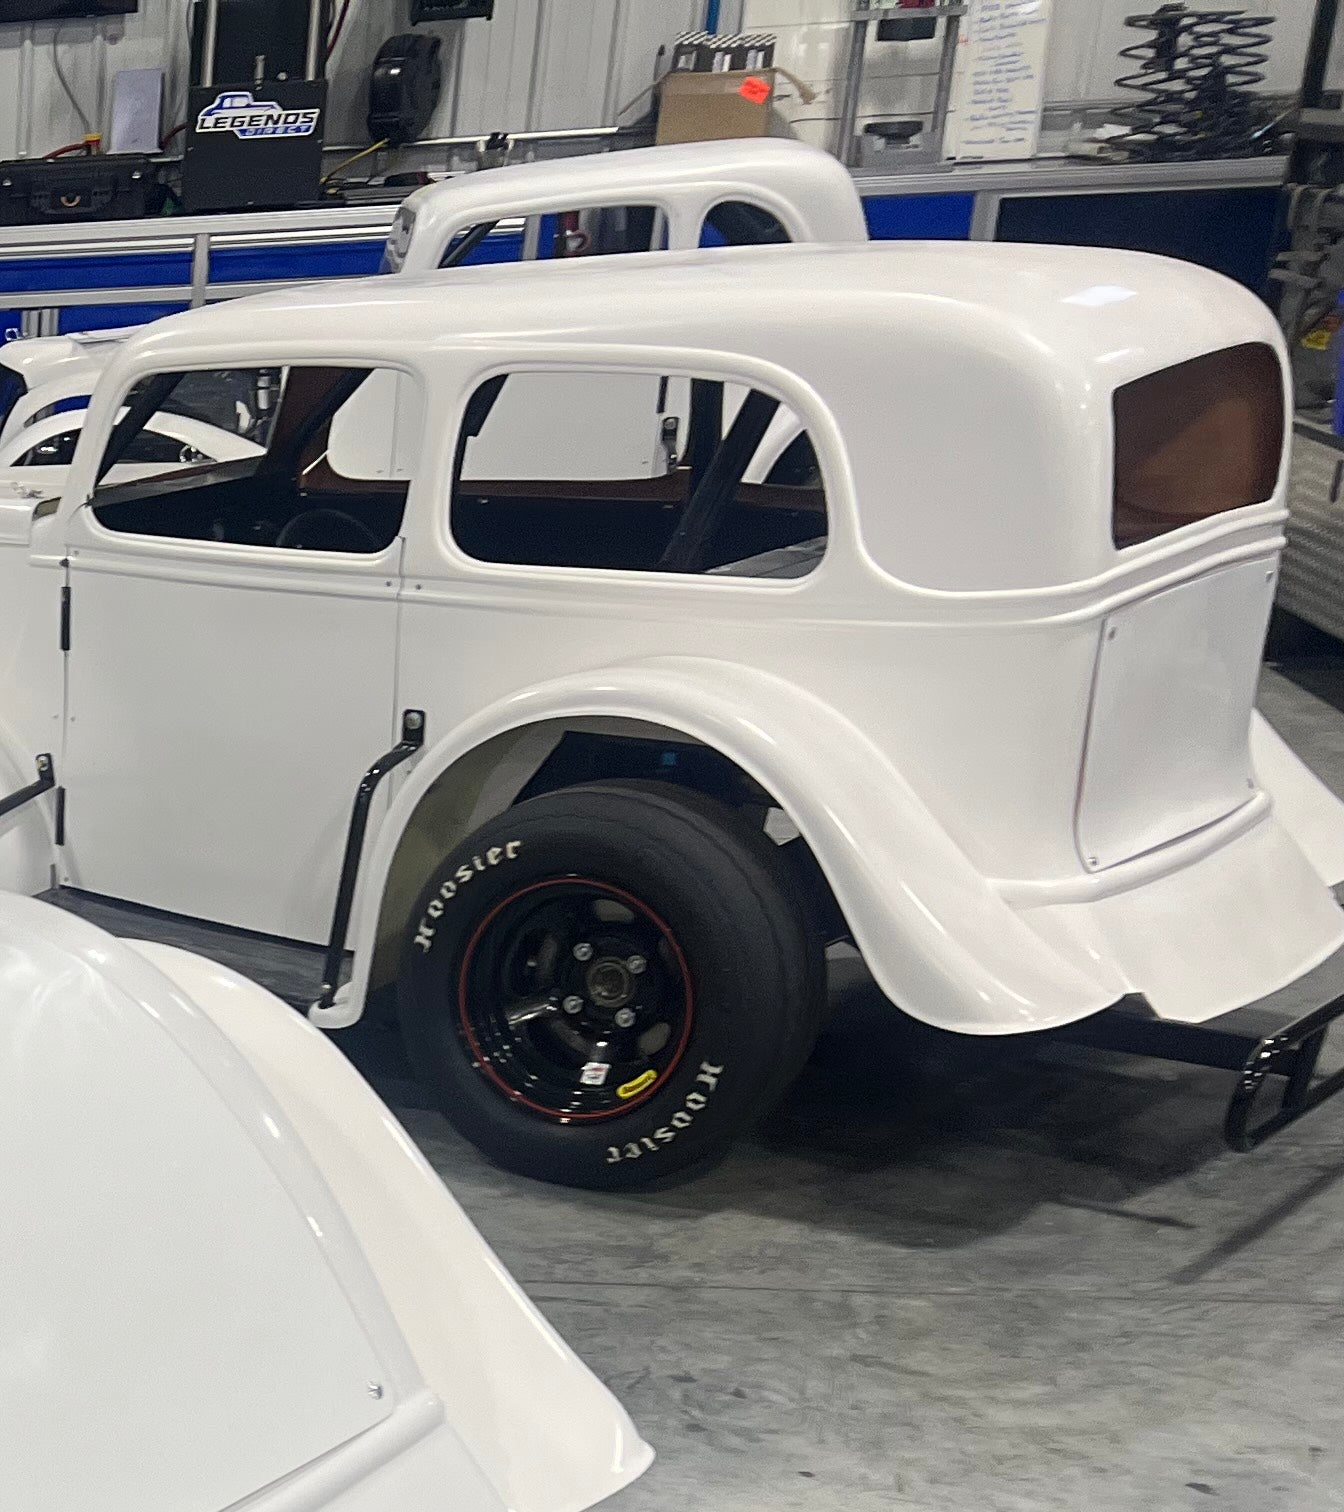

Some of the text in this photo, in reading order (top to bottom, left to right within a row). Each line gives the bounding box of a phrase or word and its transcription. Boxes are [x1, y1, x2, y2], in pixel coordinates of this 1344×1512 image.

[198, 111, 318, 129] LEGENDS
[245, 125, 311, 136] DIRECT
[413, 840, 523, 952] Hoosier
[606, 1060, 725, 1164] Hoosier
